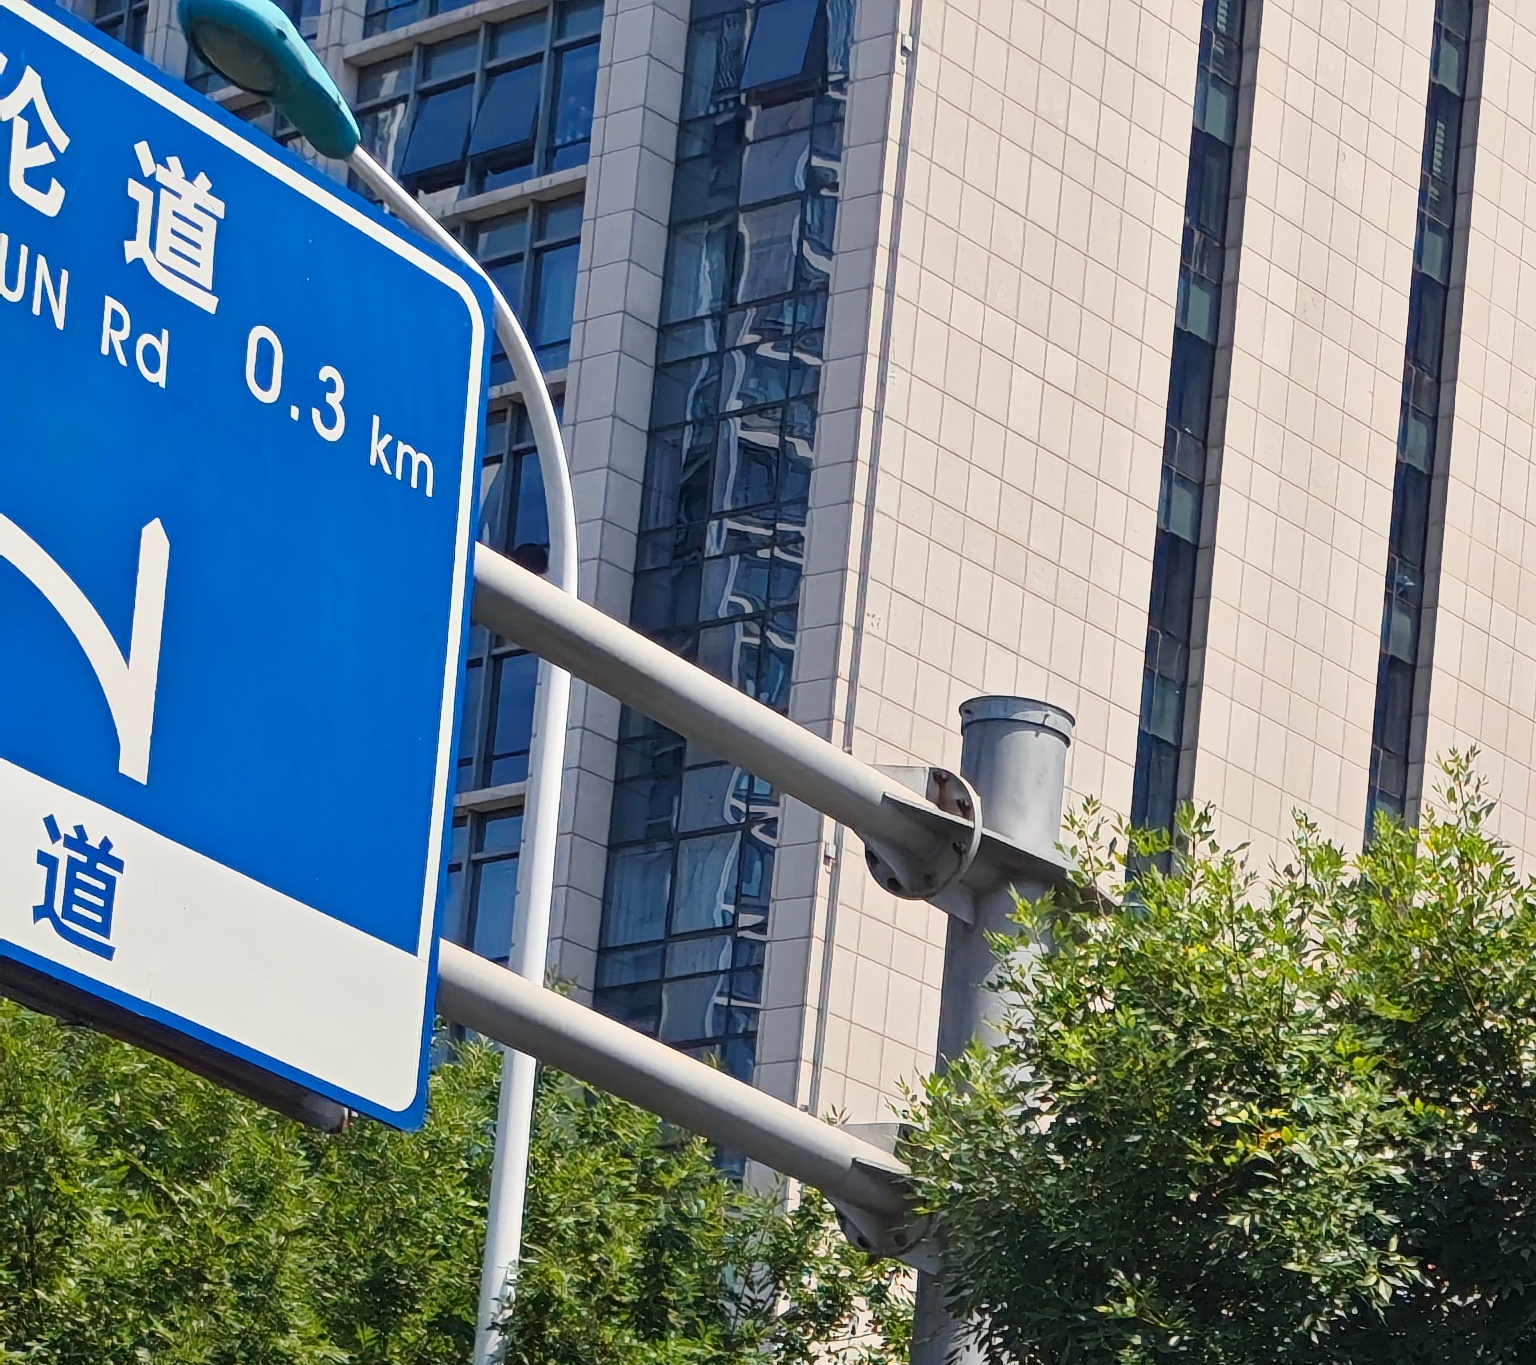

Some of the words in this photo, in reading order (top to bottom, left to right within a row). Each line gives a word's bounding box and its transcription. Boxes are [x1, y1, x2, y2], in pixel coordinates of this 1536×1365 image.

[100, 294, 170, 390] Rd
[245, 325, 347, 443] 0.3
[369, 414, 434, 498] km
[32, 813, 125, 962] 道
